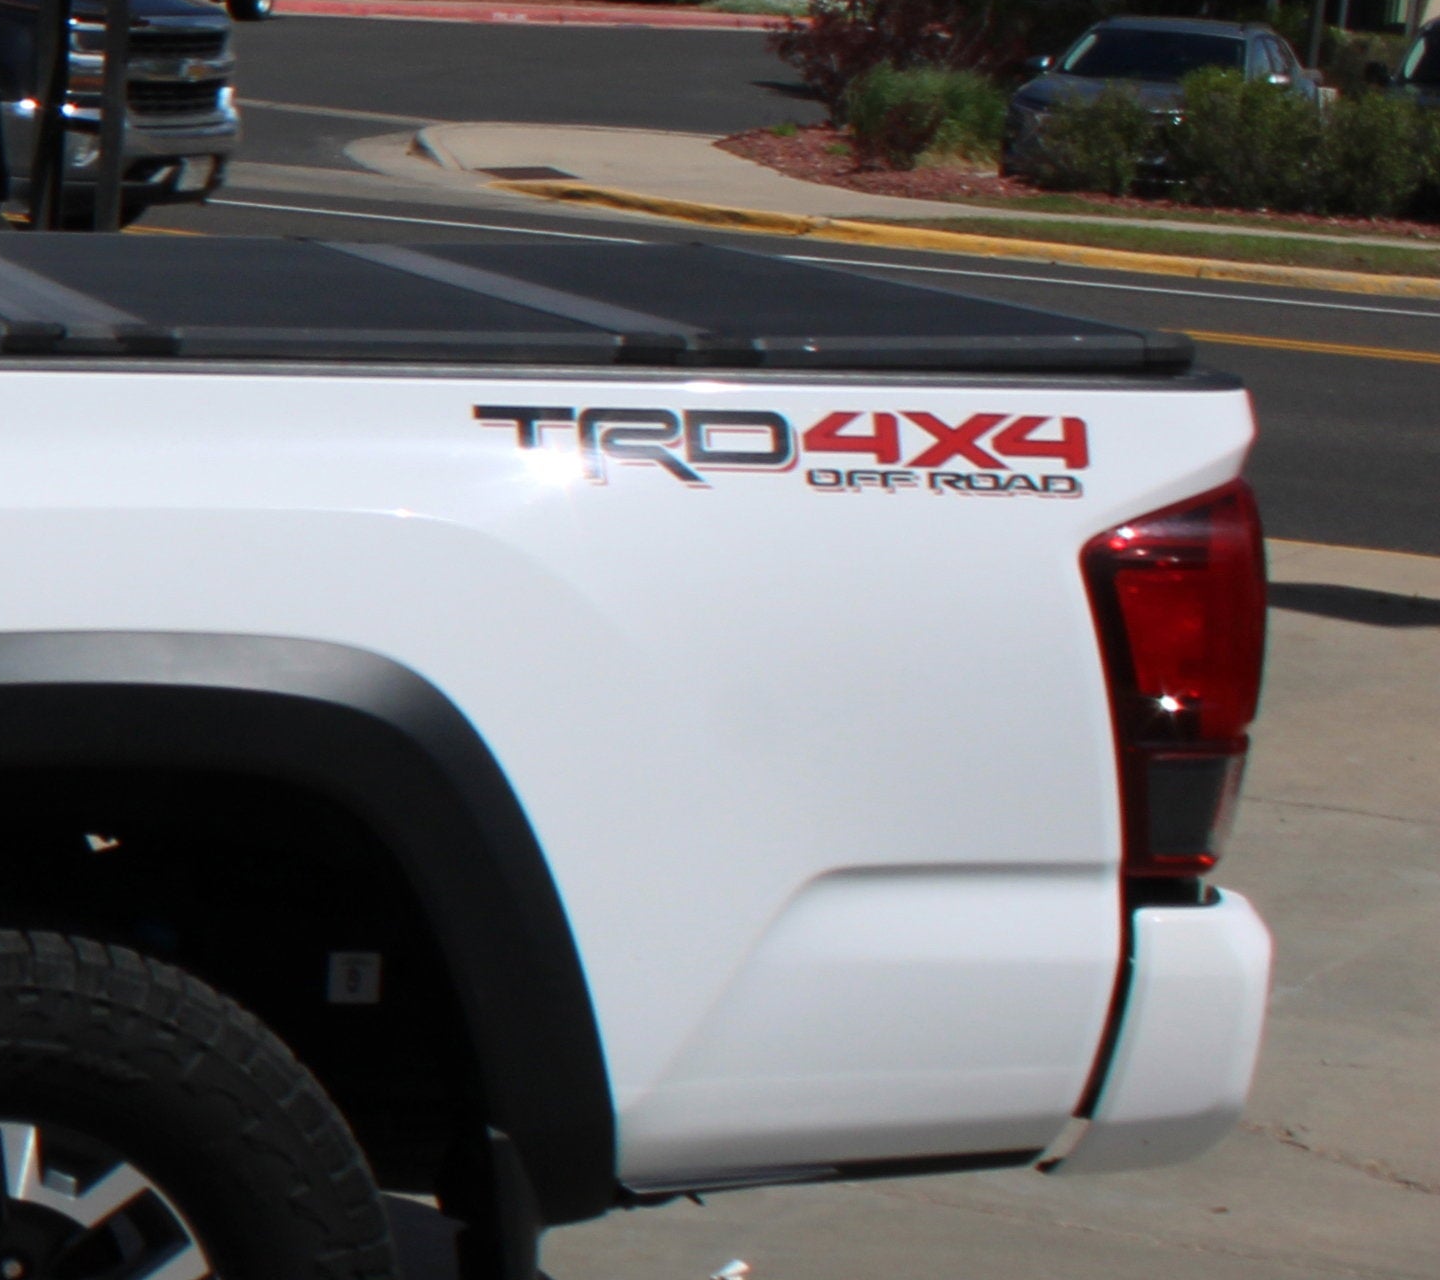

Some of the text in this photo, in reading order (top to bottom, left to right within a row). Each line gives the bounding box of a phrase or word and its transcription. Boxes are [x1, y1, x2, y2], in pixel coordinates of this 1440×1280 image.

[472, 404, 1090, 489] TRD 4X4
[806, 468, 1083, 498] OFF ROAD
